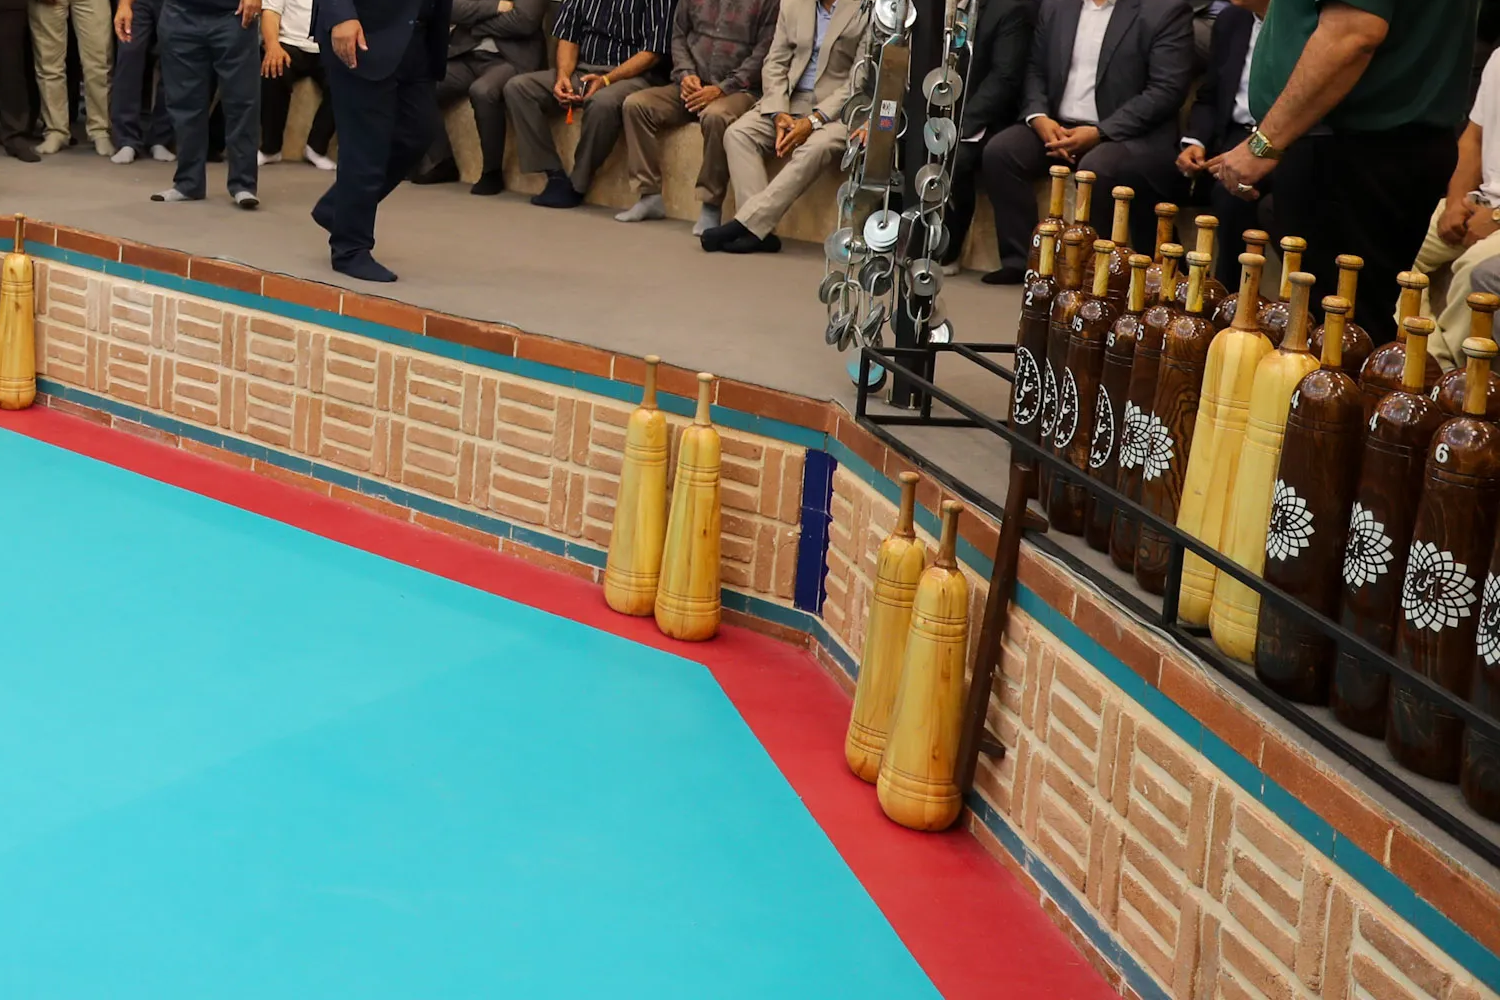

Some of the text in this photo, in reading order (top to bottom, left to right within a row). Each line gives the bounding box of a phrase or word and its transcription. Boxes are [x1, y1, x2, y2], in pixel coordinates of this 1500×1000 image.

[1033, 234, 1040, 247] 6
[1025, 292, 1033, 306] 2
[1291, 390, 1300, 408] 4
[1369, 411, 1380, 431] 4
[1435, 443, 1449, 464] 6
